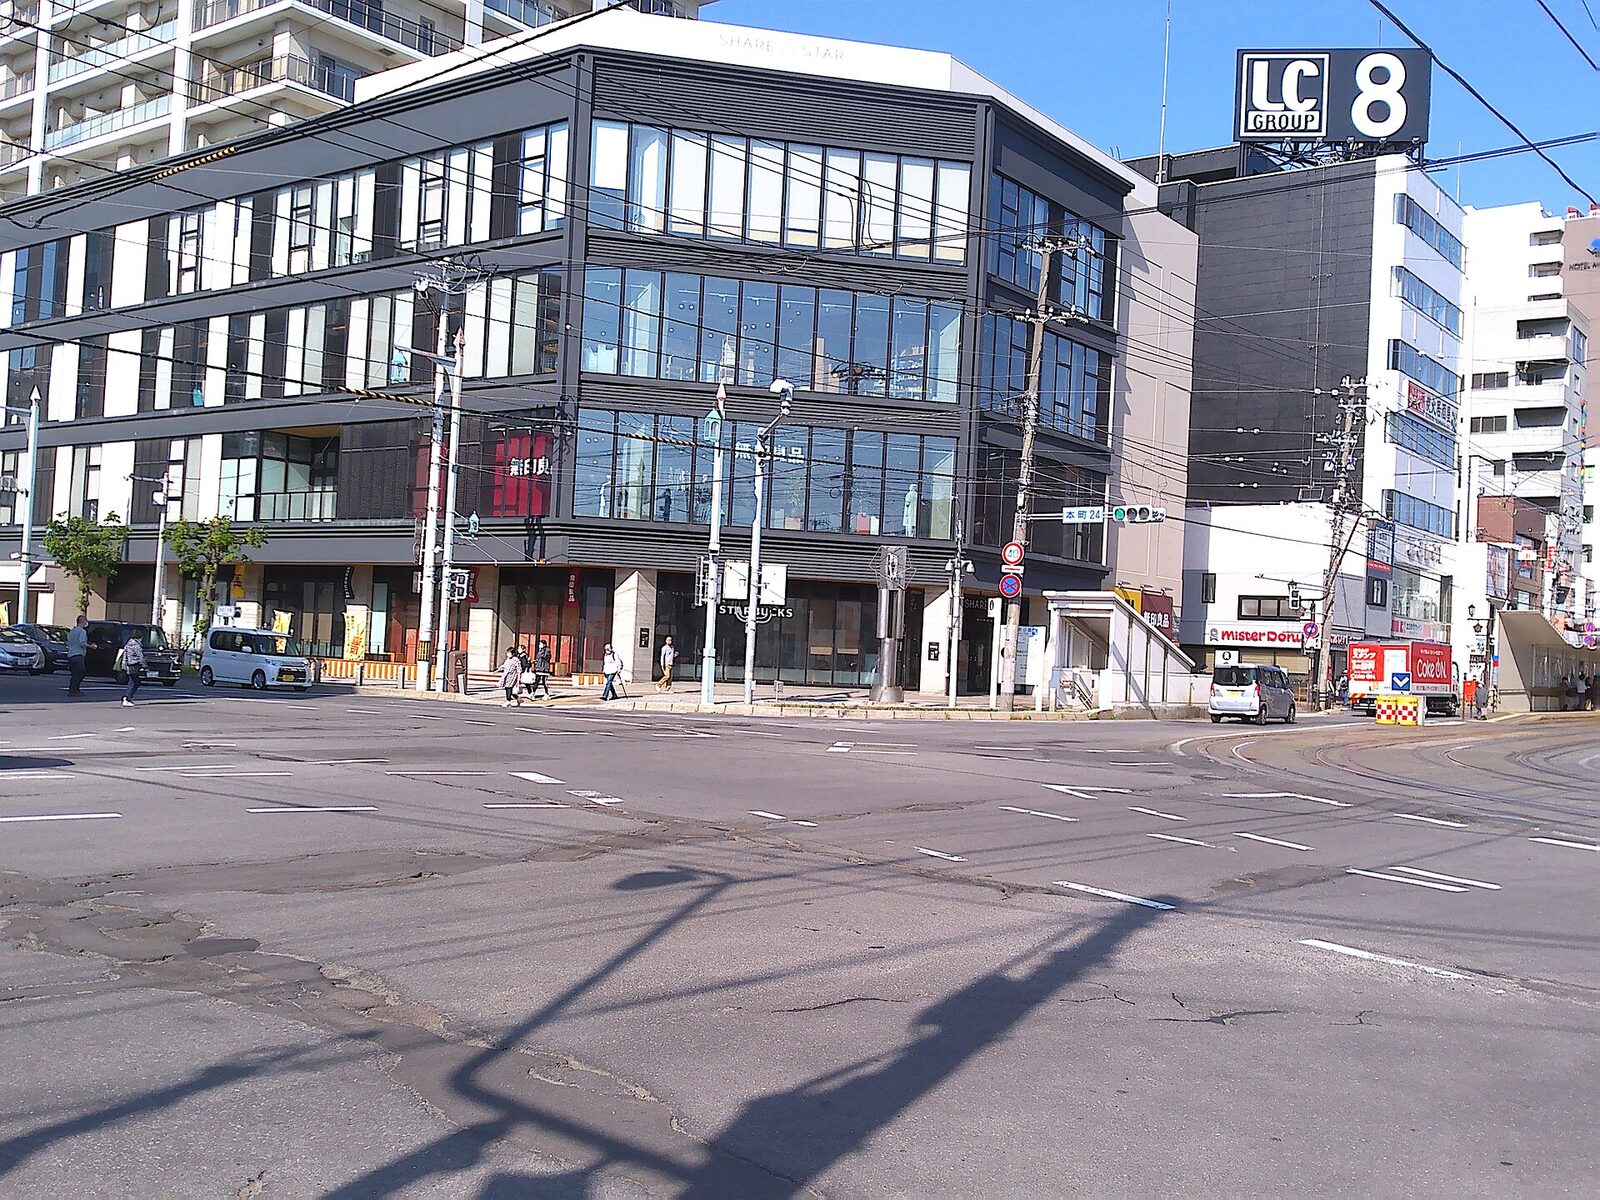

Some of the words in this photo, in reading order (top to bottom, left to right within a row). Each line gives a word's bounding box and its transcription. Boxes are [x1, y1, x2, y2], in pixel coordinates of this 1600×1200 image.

[1252, 59, 1320, 112] LC
[1351, 52, 1408, 138] 8
[1253, 114, 1315, 130] GROUP
[510, 455, 553, 476] 無印良
[1007, 548, 1019, 558] 40
[1267, 631, 1306, 643] Donu
